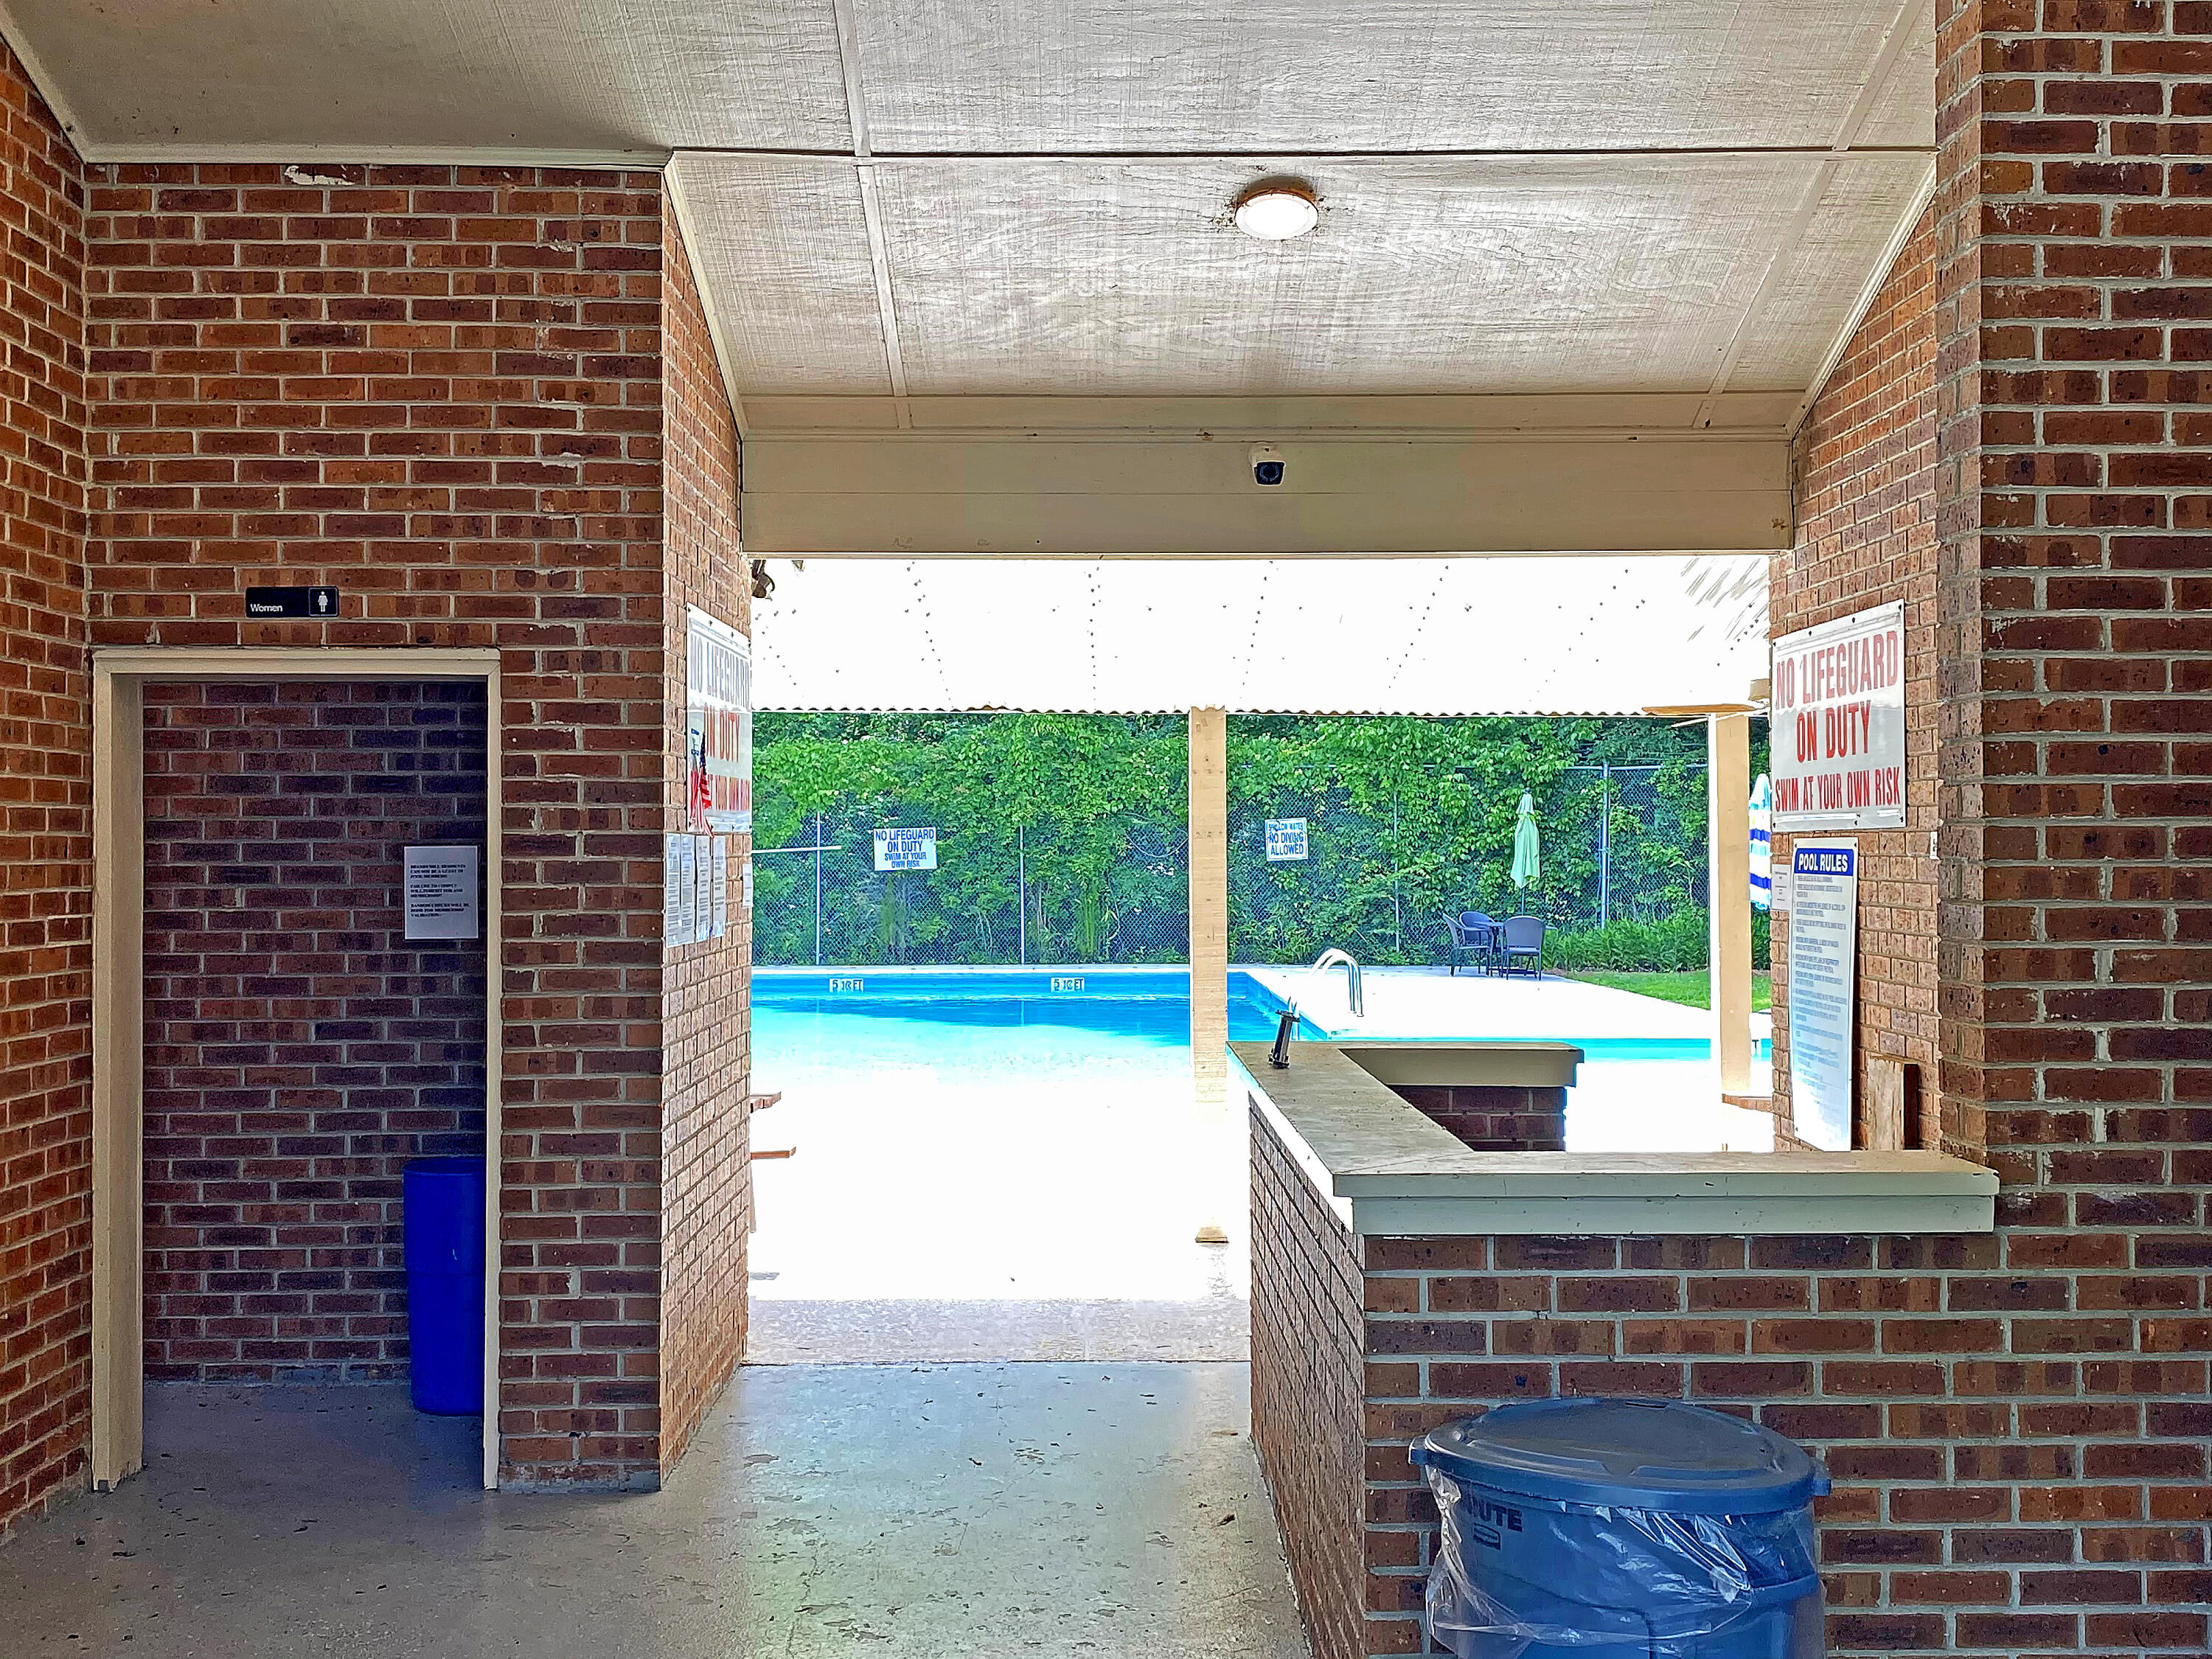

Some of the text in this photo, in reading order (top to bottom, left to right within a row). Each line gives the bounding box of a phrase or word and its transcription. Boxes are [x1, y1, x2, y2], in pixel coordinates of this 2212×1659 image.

[250, 603, 283, 612] Women
[690, 634, 750, 709] NO LIFEGUARD
[1775, 630, 1898, 709] NO LIFEGUARD
[720, 708, 740, 763] DUTY
[1796, 700, 1871, 762] ON DUTY
[1775, 766, 1901, 812] SWIM AT YOUR OWN RISK
[875, 830, 934, 841] NO LIFEGUARD
[1269, 832, 1304, 844] NO DIVING
[888, 841, 923, 852] ON DUTY
[1271, 844, 1304, 855] ALLOWED
[885, 852, 901, 860] SWIM
[906, 860, 920, 868] RISK
[1798, 853, 1848, 872] POOL RULES
[853, 979, 863, 991] FT
[1054, 978, 1060, 991] 5
